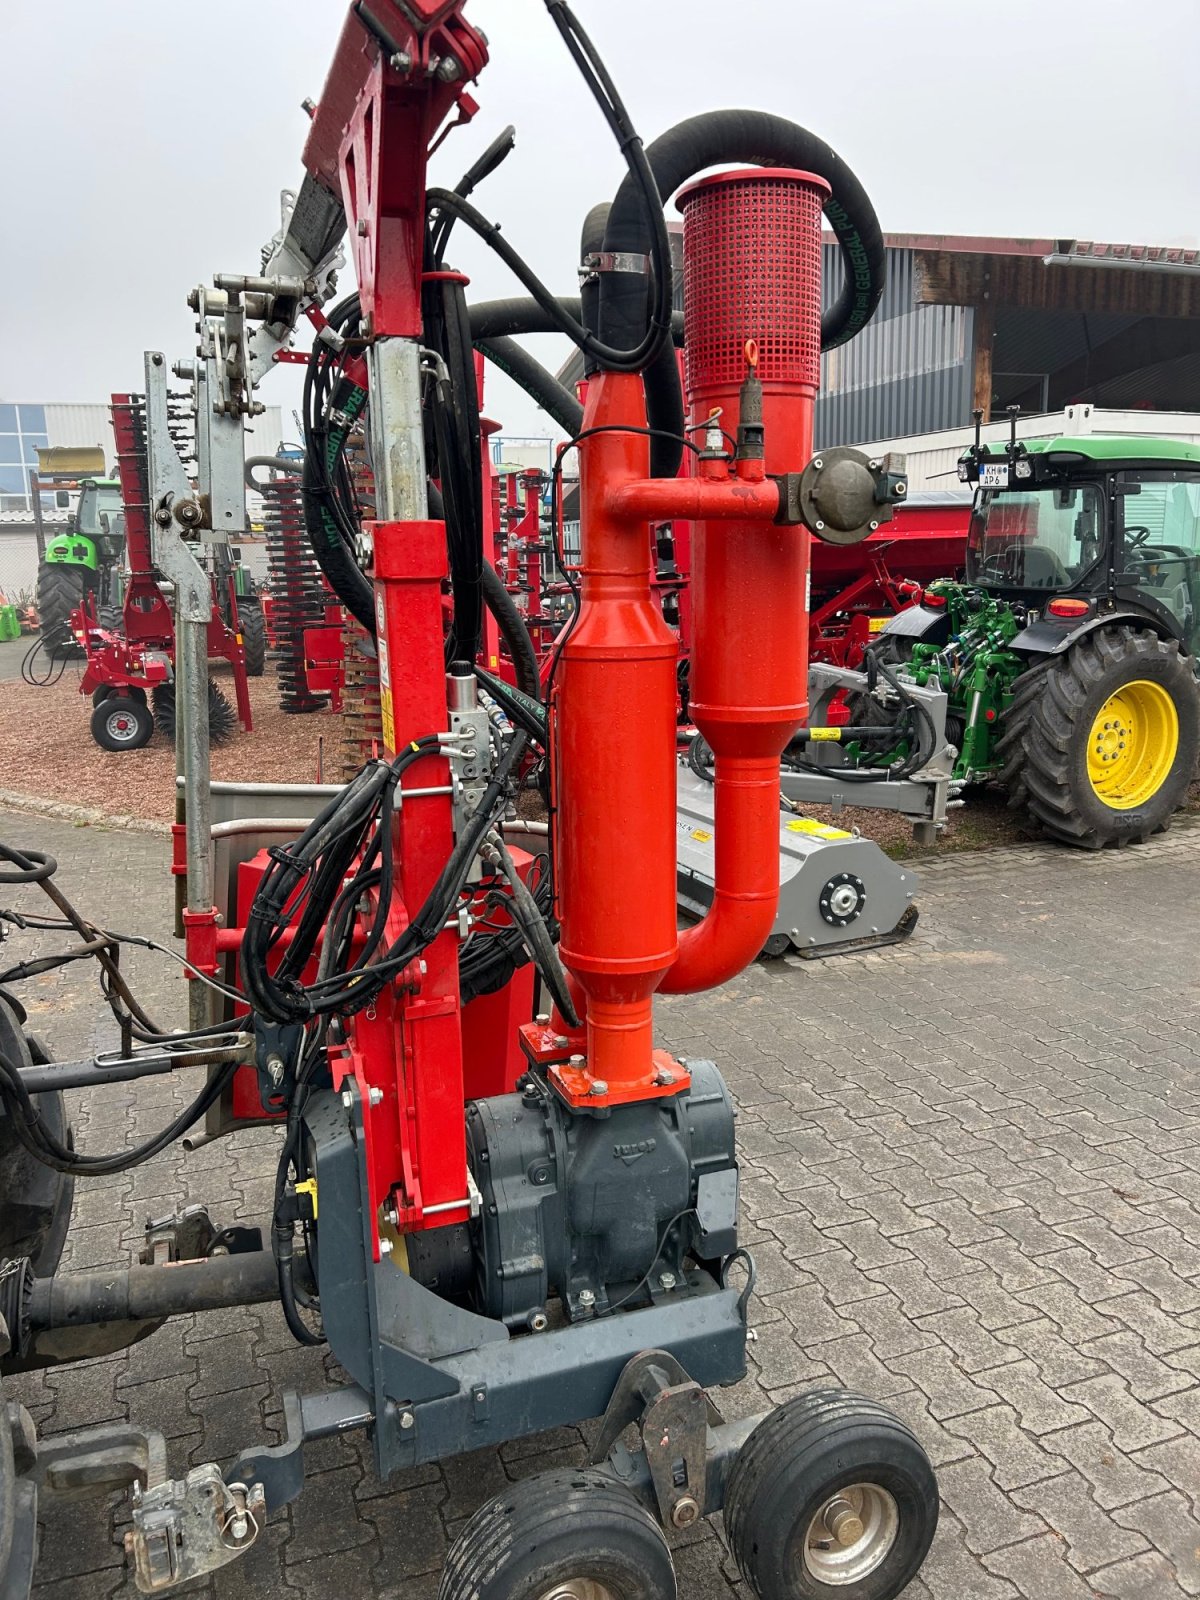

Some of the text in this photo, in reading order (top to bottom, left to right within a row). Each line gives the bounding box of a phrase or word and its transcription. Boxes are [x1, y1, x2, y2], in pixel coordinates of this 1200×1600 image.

[845, 231, 871, 289] GENERAL
[986, 466, 997, 475] KH
[984, 475, 1000, 485] AP 6
[515, 694, 537, 710] ITALY
